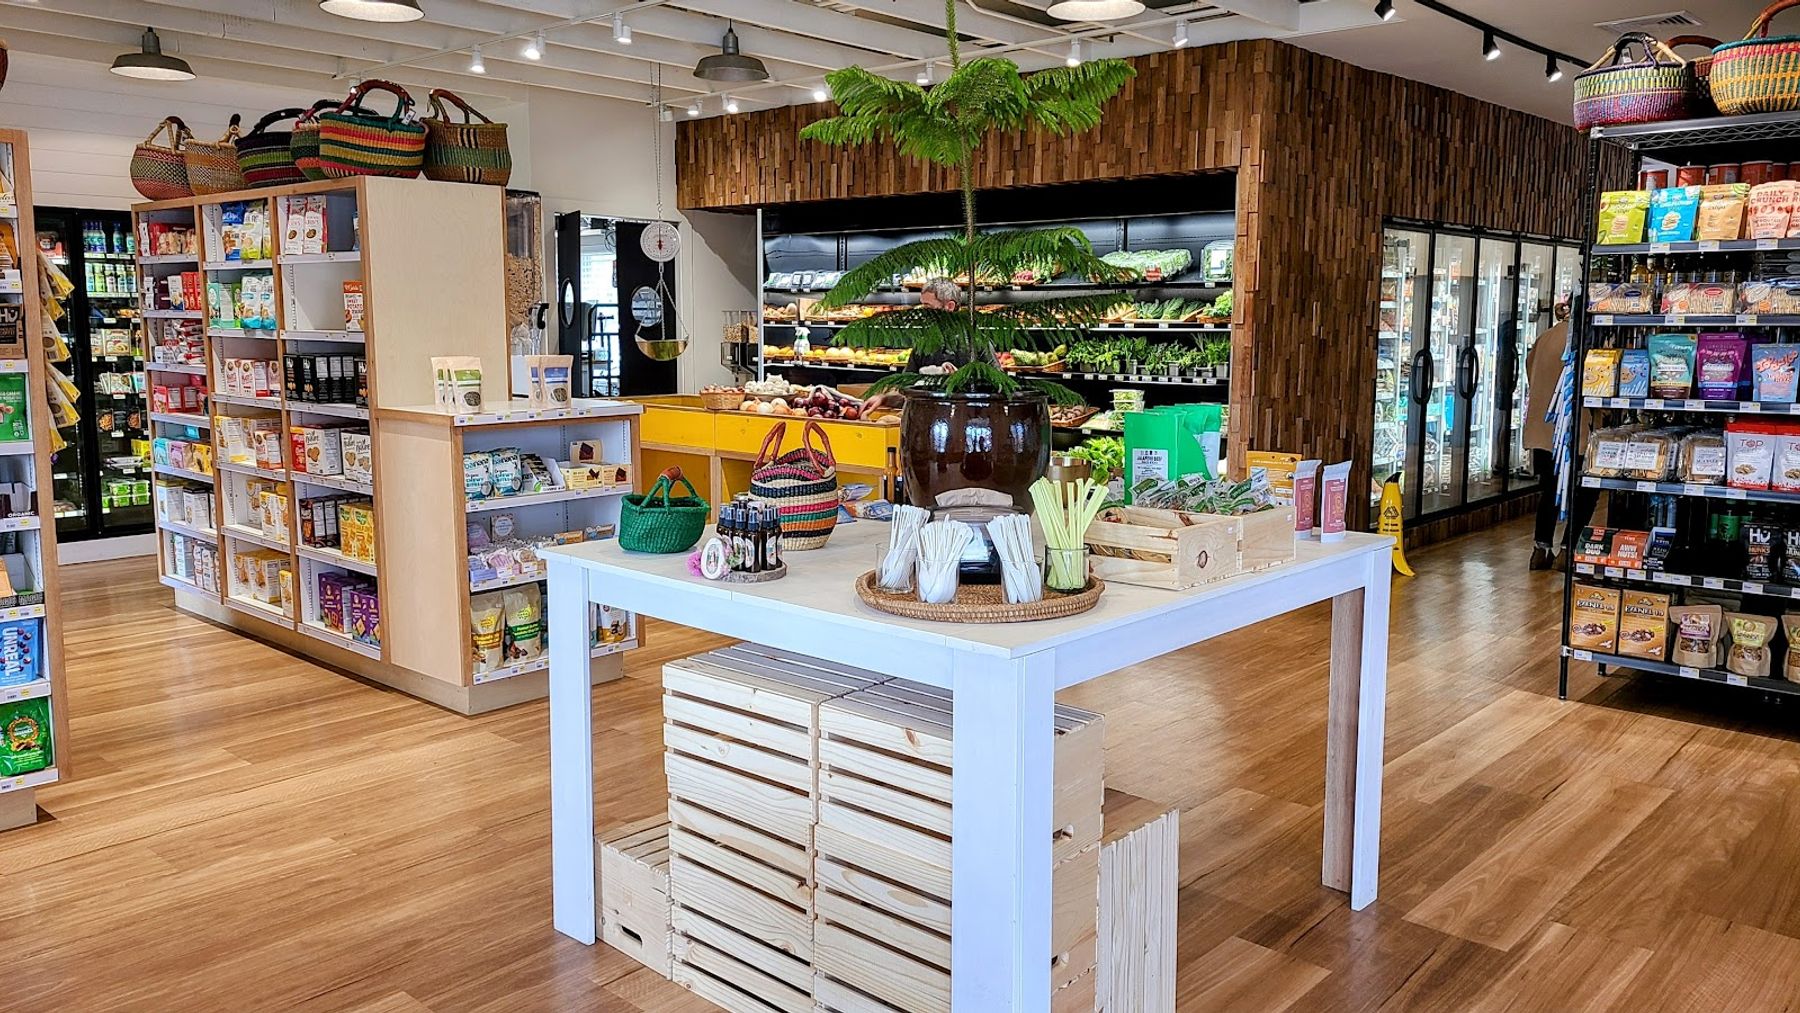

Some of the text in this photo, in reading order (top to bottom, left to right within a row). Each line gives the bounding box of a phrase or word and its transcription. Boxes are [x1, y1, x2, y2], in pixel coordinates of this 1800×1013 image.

[1756, 190, 1785, 198] DAILY
[1750, 196, 1790, 205] CRUNCH
[7, 510, 36, 518] ORGANIC
[1584, 542, 1605, 551] DARK
[1584, 548, 1602, 556] DUO
[2, 626, 21, 678] UNREAL
